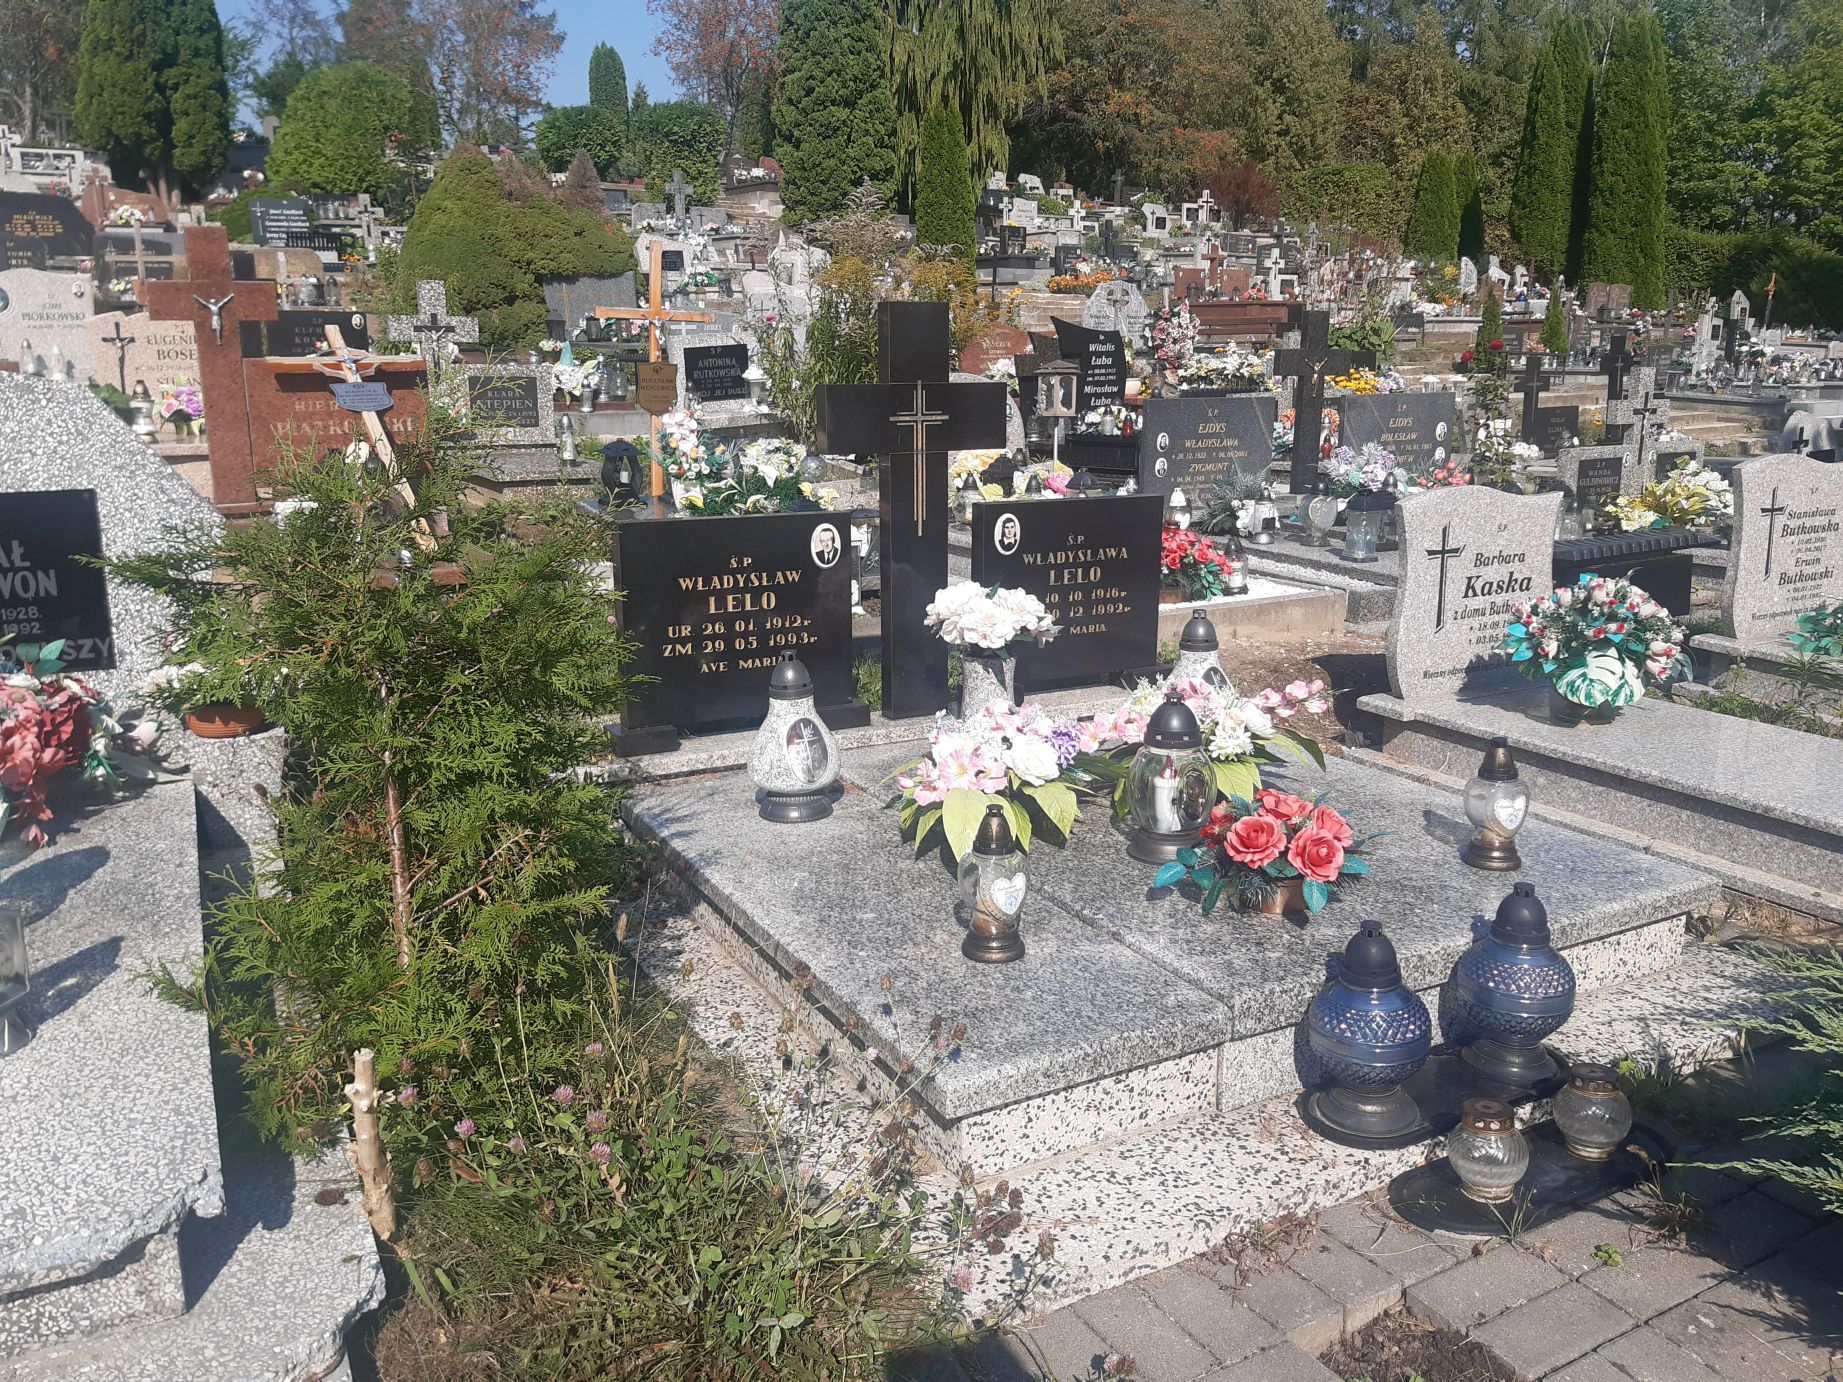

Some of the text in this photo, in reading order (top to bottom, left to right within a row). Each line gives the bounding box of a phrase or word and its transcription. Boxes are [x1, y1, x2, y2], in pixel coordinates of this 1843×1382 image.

[1089, 343, 1115, 352] Witalis
[157, 348, 198, 360] BOSE
[698, 357, 737, 368] ANTONINA
[1091, 355, 1112, 365] Łuba
[693, 368, 742, 379] RUTKOWSKA
[1084, 384, 1118, 393] Mirosław
[1091, 396, 1112, 406] Łuba
[1198, 423, 1226, 433] EJDYS
[1389, 417, 1414, 428] EJDYS
[1184, 438, 1238, 448] WŁADYSŁAWA
[1189, 462, 1229, 472] ZYGMUNT
[1787, 507, 1836, 520] Stanisława
[1781, 519, 1839, 538] Butkowska
[1022, 547, 1128, 565] WŁADYSŁAWA
[1474, 550, 1526, 568] Barbara
[1794, 557, 1820, 567] Erwin
[678, 570, 801, 591] WŁADYSŁAW
[1049, 566, 1101, 586] LELO
[1778, 566, 1834, 586] Butkowski
[1462, 570, 1532, 599] Kaska
[708, 592, 776, 614] LELO
[1454, 610, 1459, 620] z
[1460, 604, 1486, 620] domu
[668, 625, 695, 638] UR.
[702, 622, 727, 635] 26.
[1070, 624, 1106, 634] MARIA
[663, 643, 696, 657] ZM.
[702, 640, 727, 653] 29.
[700, 662, 728, 673] AVE
